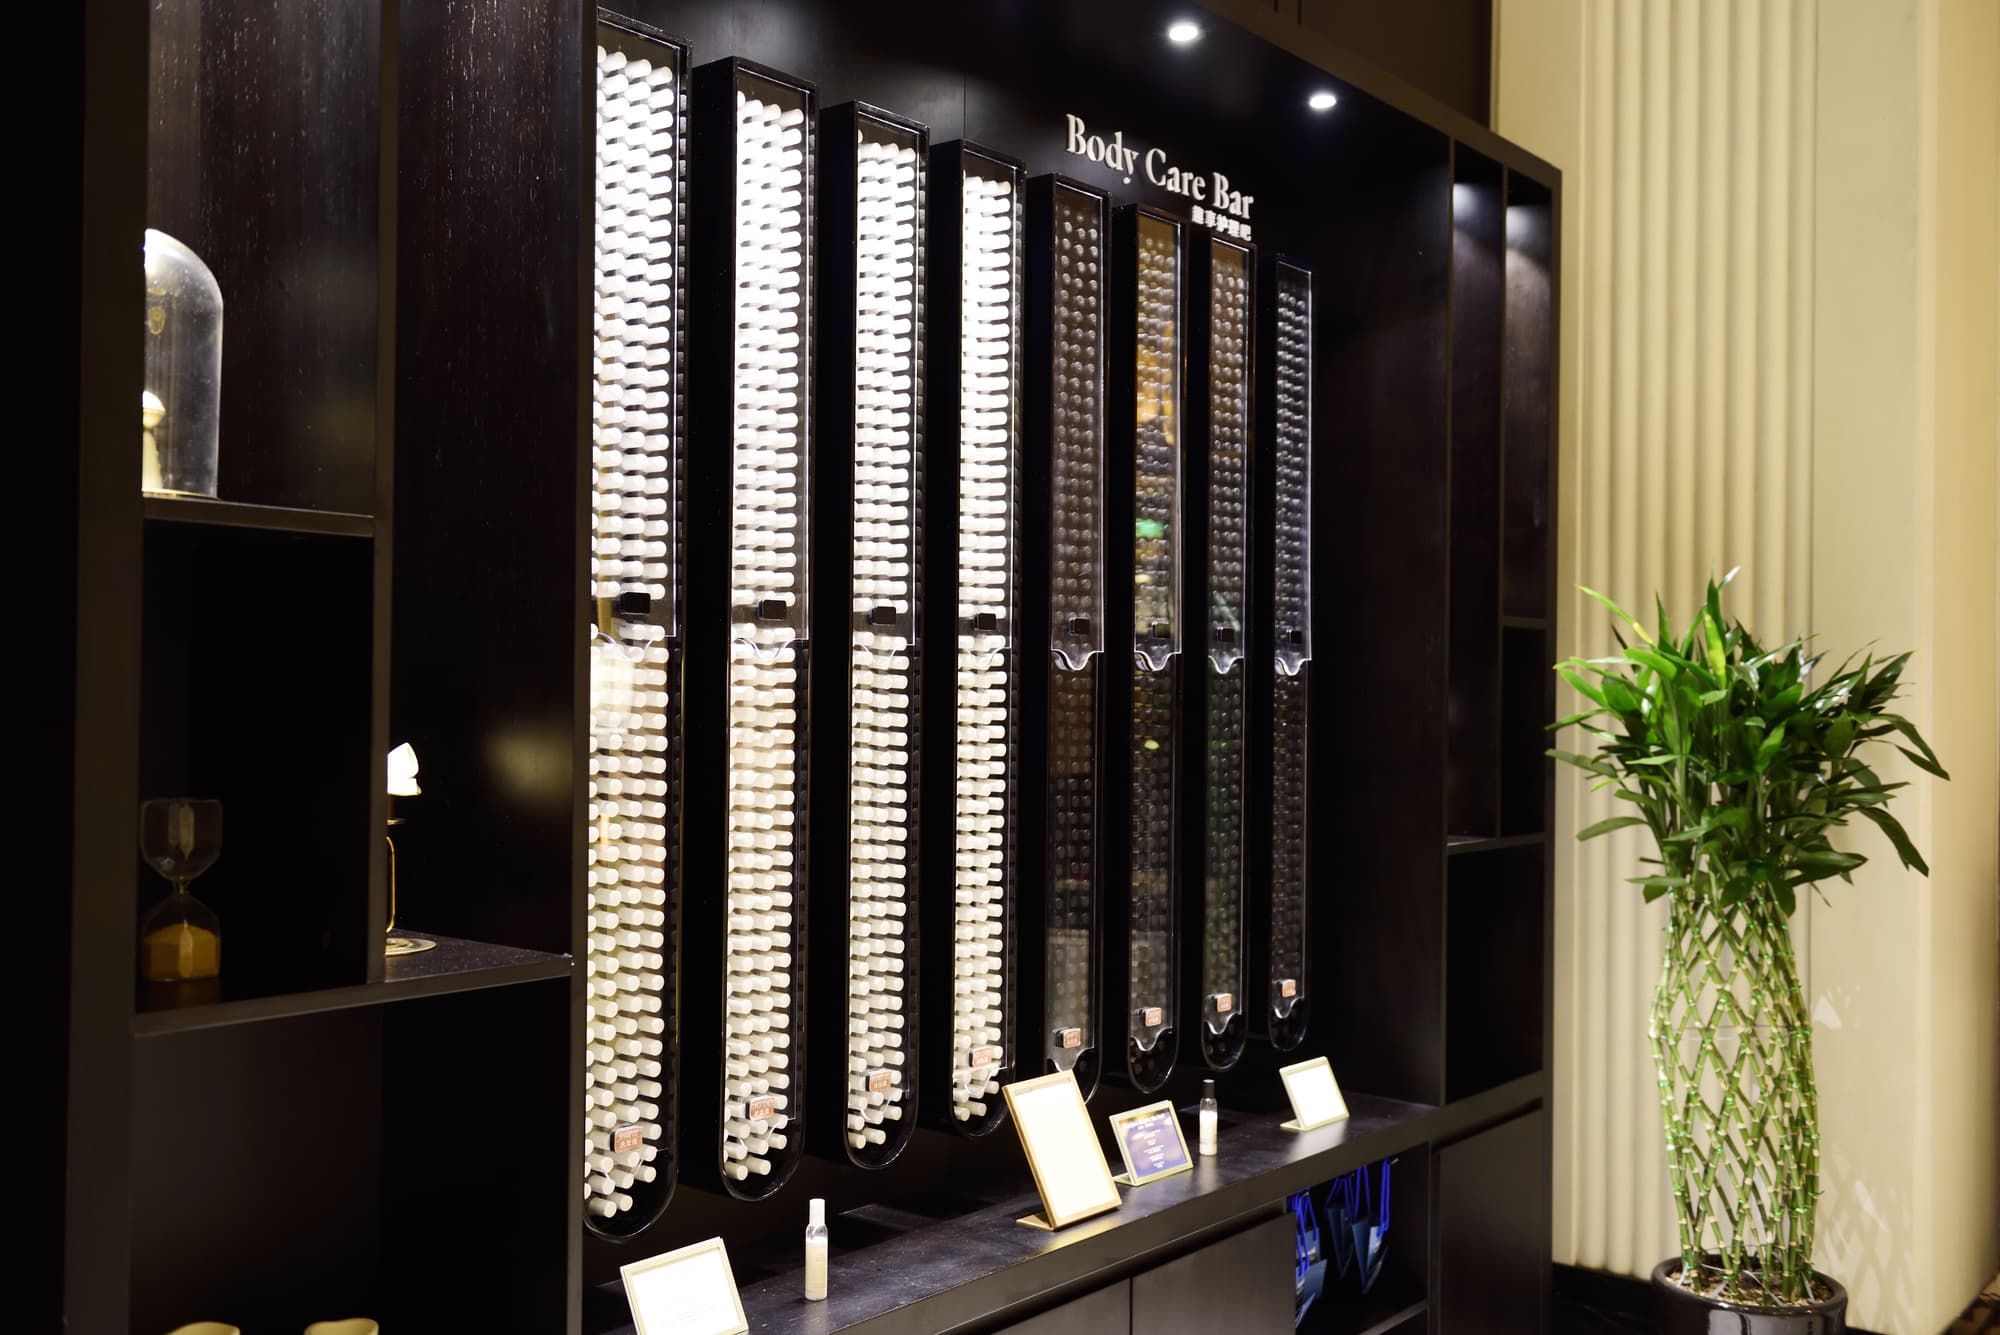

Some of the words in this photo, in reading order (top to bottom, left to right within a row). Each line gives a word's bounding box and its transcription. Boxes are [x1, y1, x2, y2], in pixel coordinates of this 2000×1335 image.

[1066, 113, 1139, 184] Body
[1145, 148, 1206, 200] Care
[1212, 172, 1254, 219] Bar
